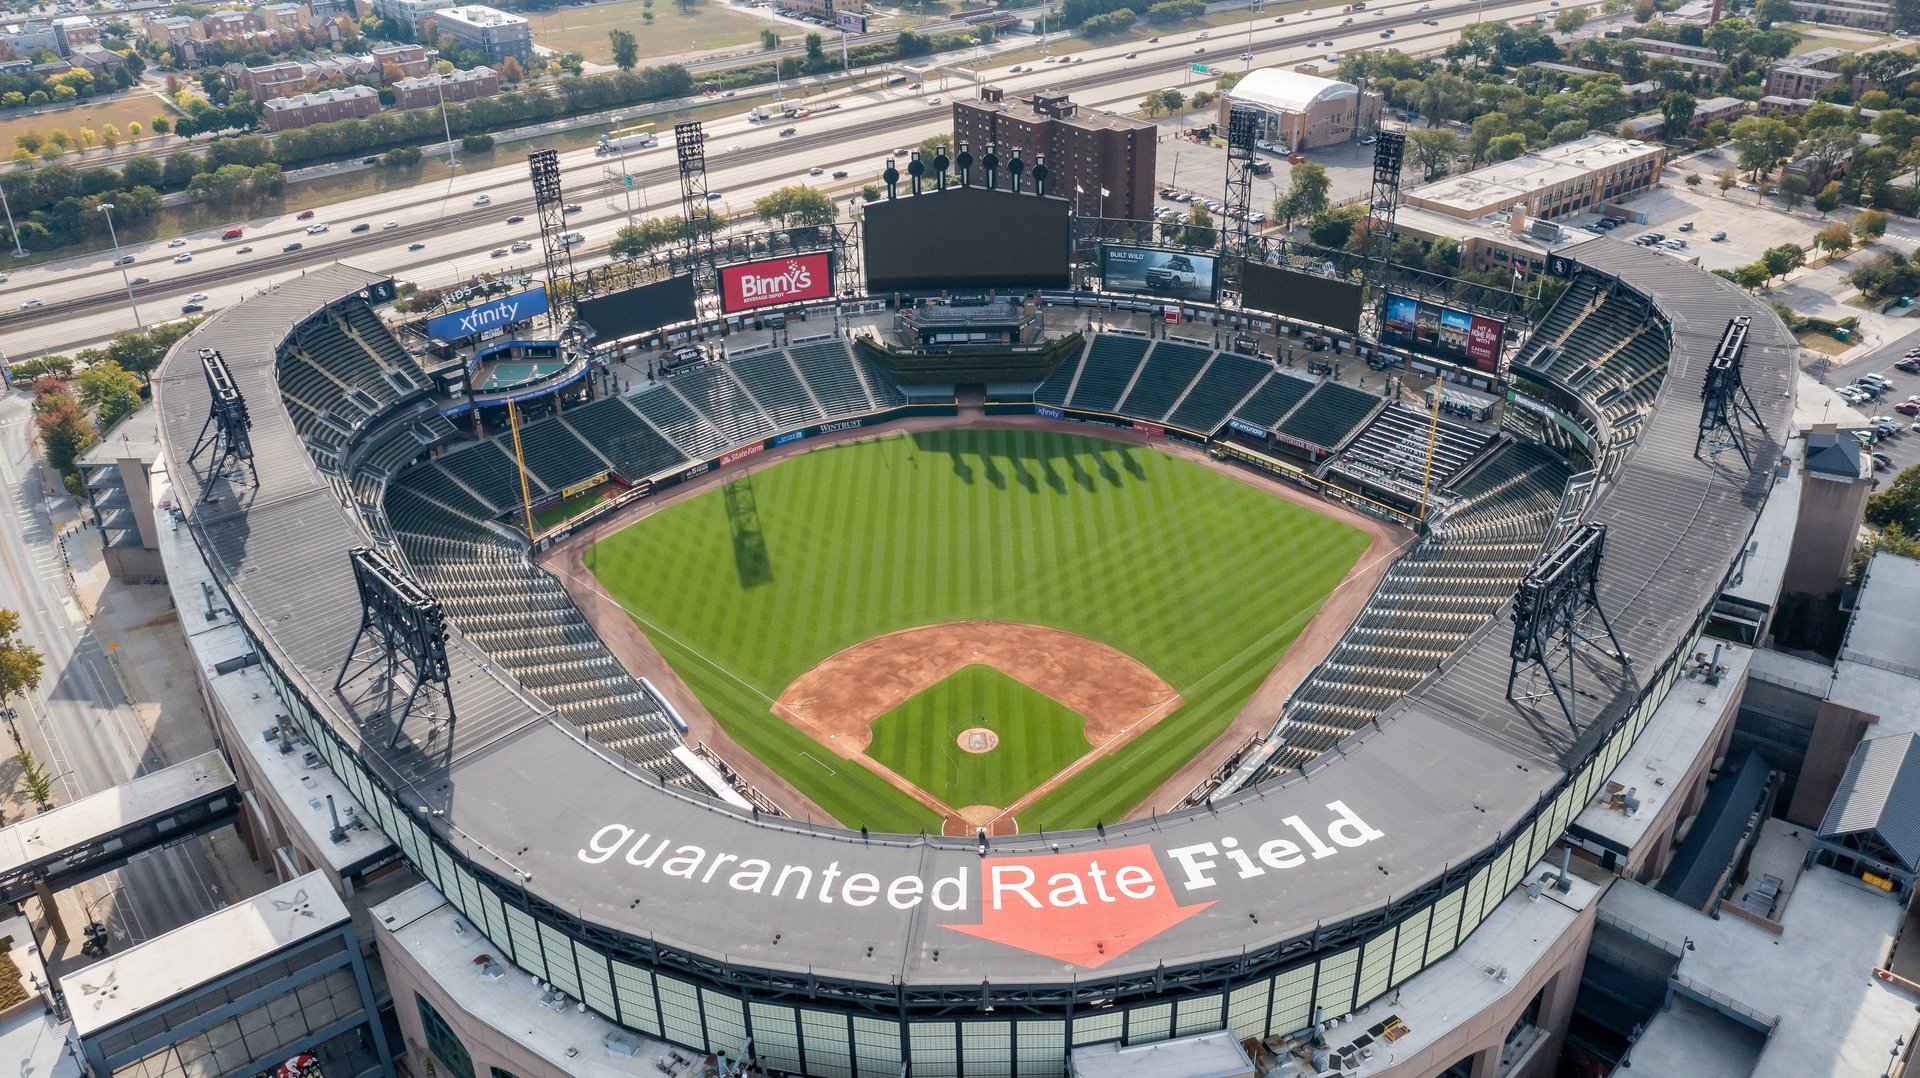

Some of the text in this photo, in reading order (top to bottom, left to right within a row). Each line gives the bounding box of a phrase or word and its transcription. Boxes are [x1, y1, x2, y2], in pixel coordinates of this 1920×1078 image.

[1110, 251, 1144, 260] BUILT WILD
[442, 286, 472, 306] KIDS
[496, 275, 529, 287] ZONE
[744, 294, 768, 303] BEVERAGE
[460, 302, 518, 331] xfinity
[1471, 329, 1496, 341] HOME RUN
[680, 352, 697, 360] Modelo
[1038, 408, 1060, 418] xfinity
[820, 420, 862, 432] WINTRUST
[1240, 424, 1263, 436] HYUNDAI
[731, 444, 764, 462] State Farm
[578, 800, 1386, 911] guaranteed Rate Field
